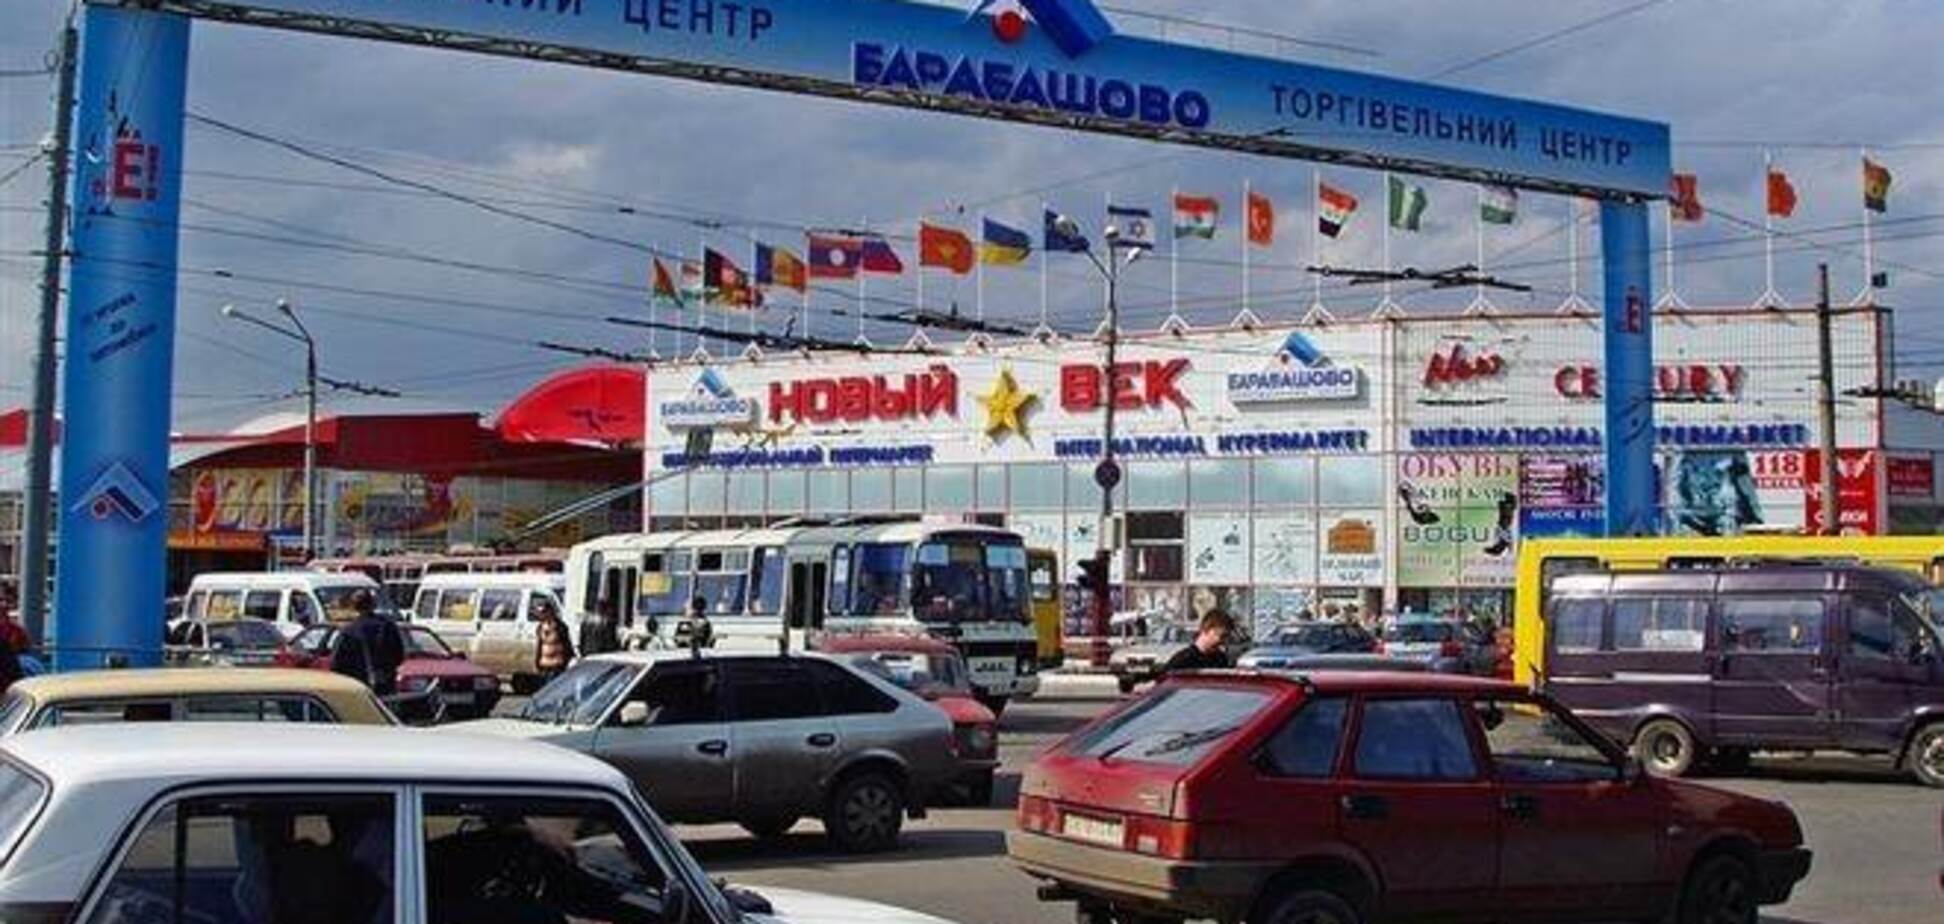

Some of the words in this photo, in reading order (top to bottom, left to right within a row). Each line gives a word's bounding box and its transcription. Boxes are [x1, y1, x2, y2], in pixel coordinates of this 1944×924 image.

[623, 0, 773, 39] ЦЕНТР
[852, 40, 1211, 129] БАРАБАШОВО
[1270, 84, 1518, 150] ТОРГІВЕЛЬНИЙ
[1540, 125, 1632, 166] ЦЕНТР
[767, 363, 959, 423] НОВЫЙ
[1060, 358, 1194, 413] ВЕК
[1227, 369, 1353, 391] БАРАБАШОВО
[1554, 365, 1744, 398] CEURY
[1410, 427, 1600, 447] INTERNATIONAL
[1654, 424, 1807, 446] PERMARKET
[1403, 454, 1513, 479] ОБУВЬ
[1755, 453, 1799, 475] 118
